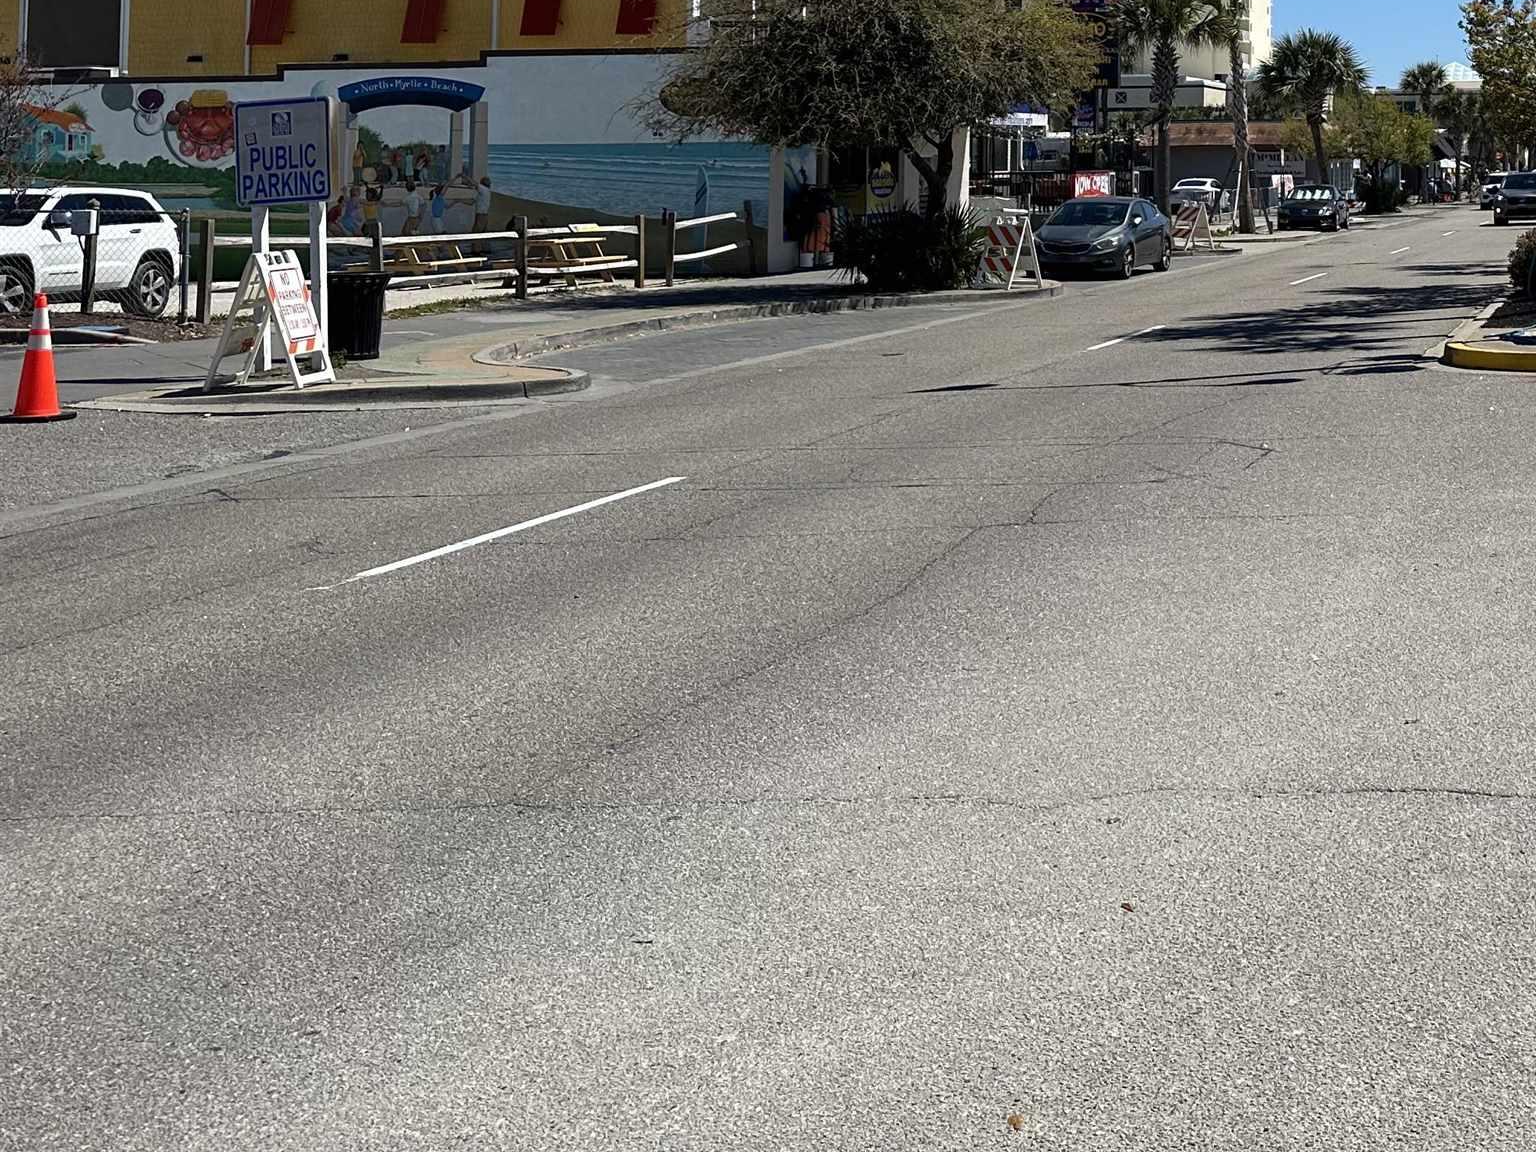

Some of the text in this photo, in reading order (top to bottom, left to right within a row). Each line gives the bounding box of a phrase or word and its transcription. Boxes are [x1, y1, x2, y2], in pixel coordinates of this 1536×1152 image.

[360, 79, 458, 93] North Myrtle Beach
[250, 143, 317, 172] PUBLIC
[242, 169, 326, 200] PARKING
[1074, 176, 1091, 197] NOW
[280, 272, 291, 286] NO
